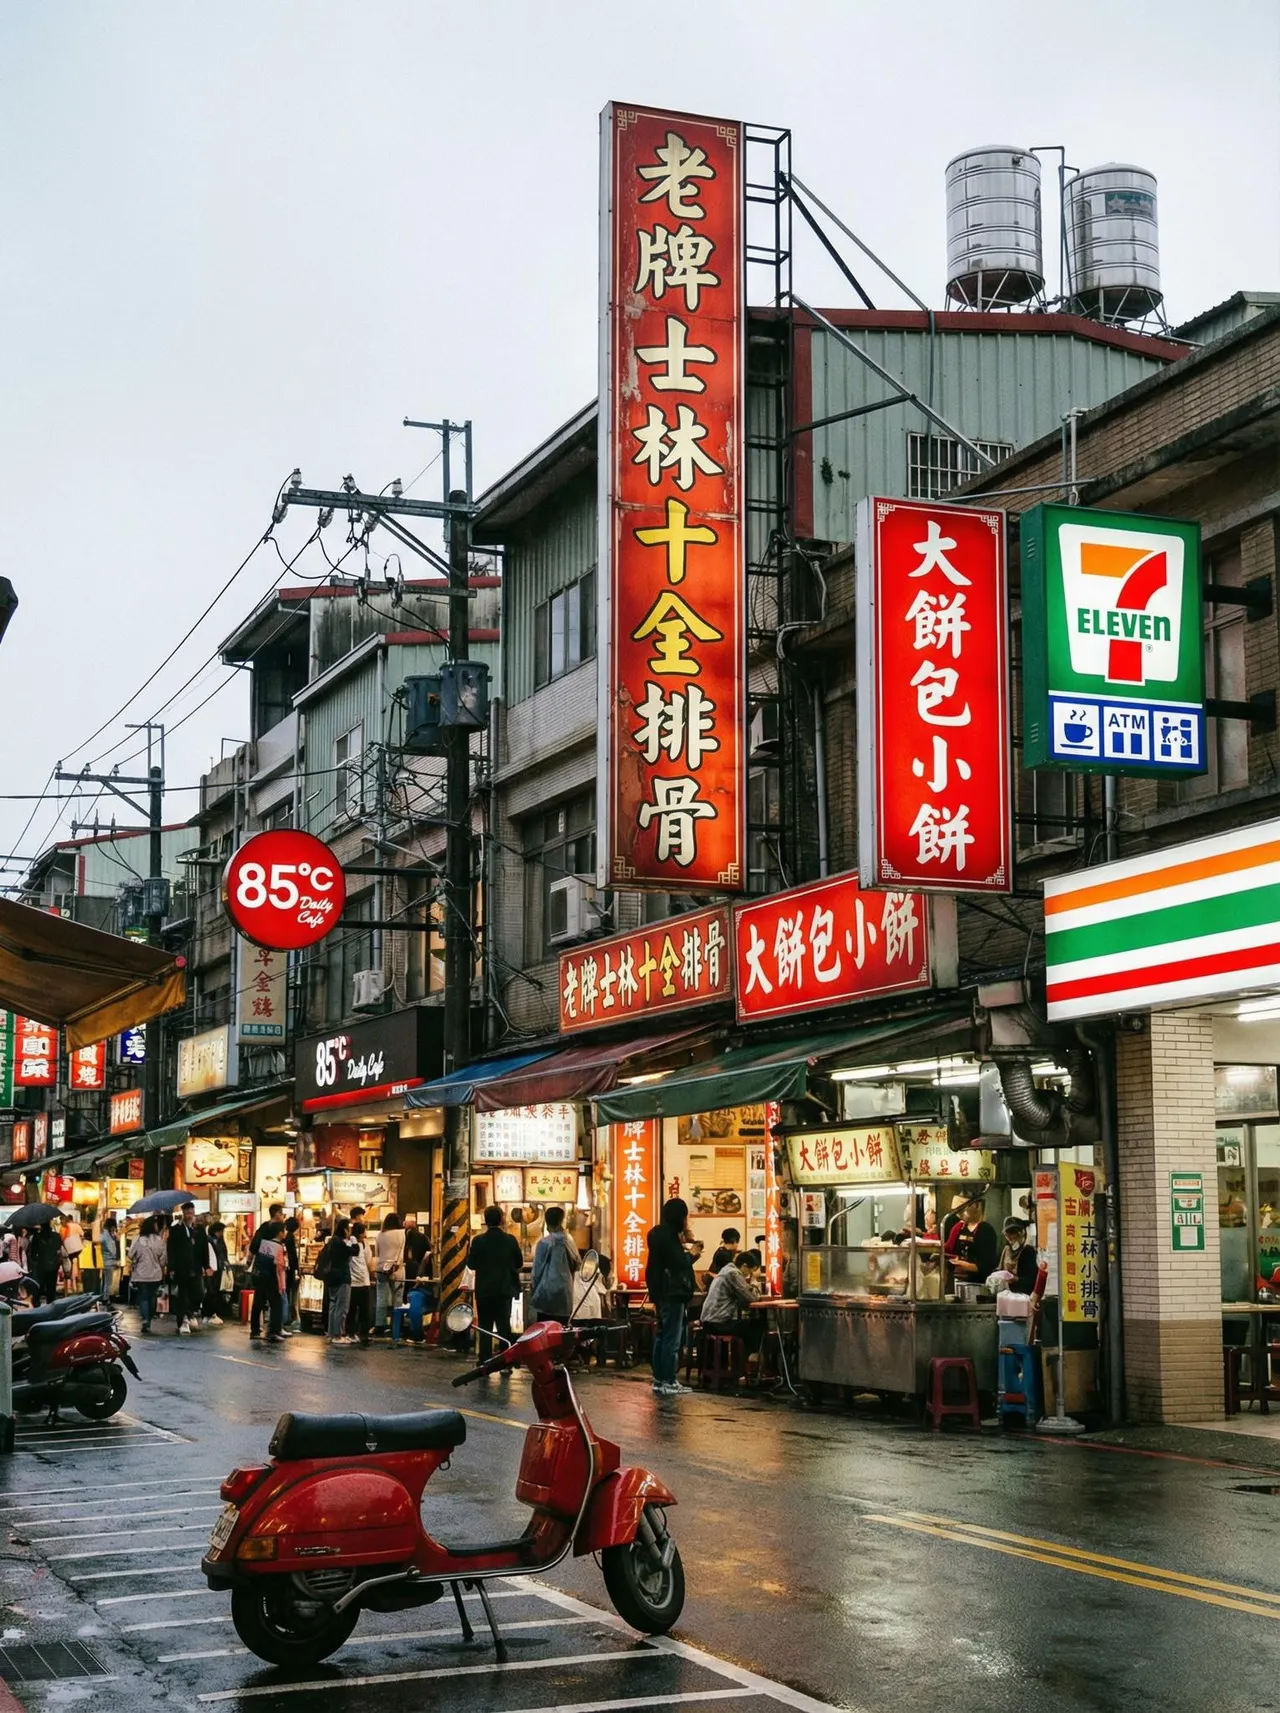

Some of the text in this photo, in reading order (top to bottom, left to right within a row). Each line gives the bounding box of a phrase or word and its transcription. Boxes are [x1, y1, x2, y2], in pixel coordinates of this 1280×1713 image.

[633, 132, 724, 866] 老牌士林十全排骨
[905, 520, 975, 872] 大餅包小餅
[1108, 712, 1146, 730] ATM
[236, 862, 334, 910] 85°C
[300, 896, 334, 914] Daily
[563, 919, 727, 1019] 老牌士林十全排骨
[745, 892, 919, 995] 大餅包小餅
[800, 1132, 883, 1171] 大餅包小餅
[1080, 1221, 1099, 1318] 士林小排骨
